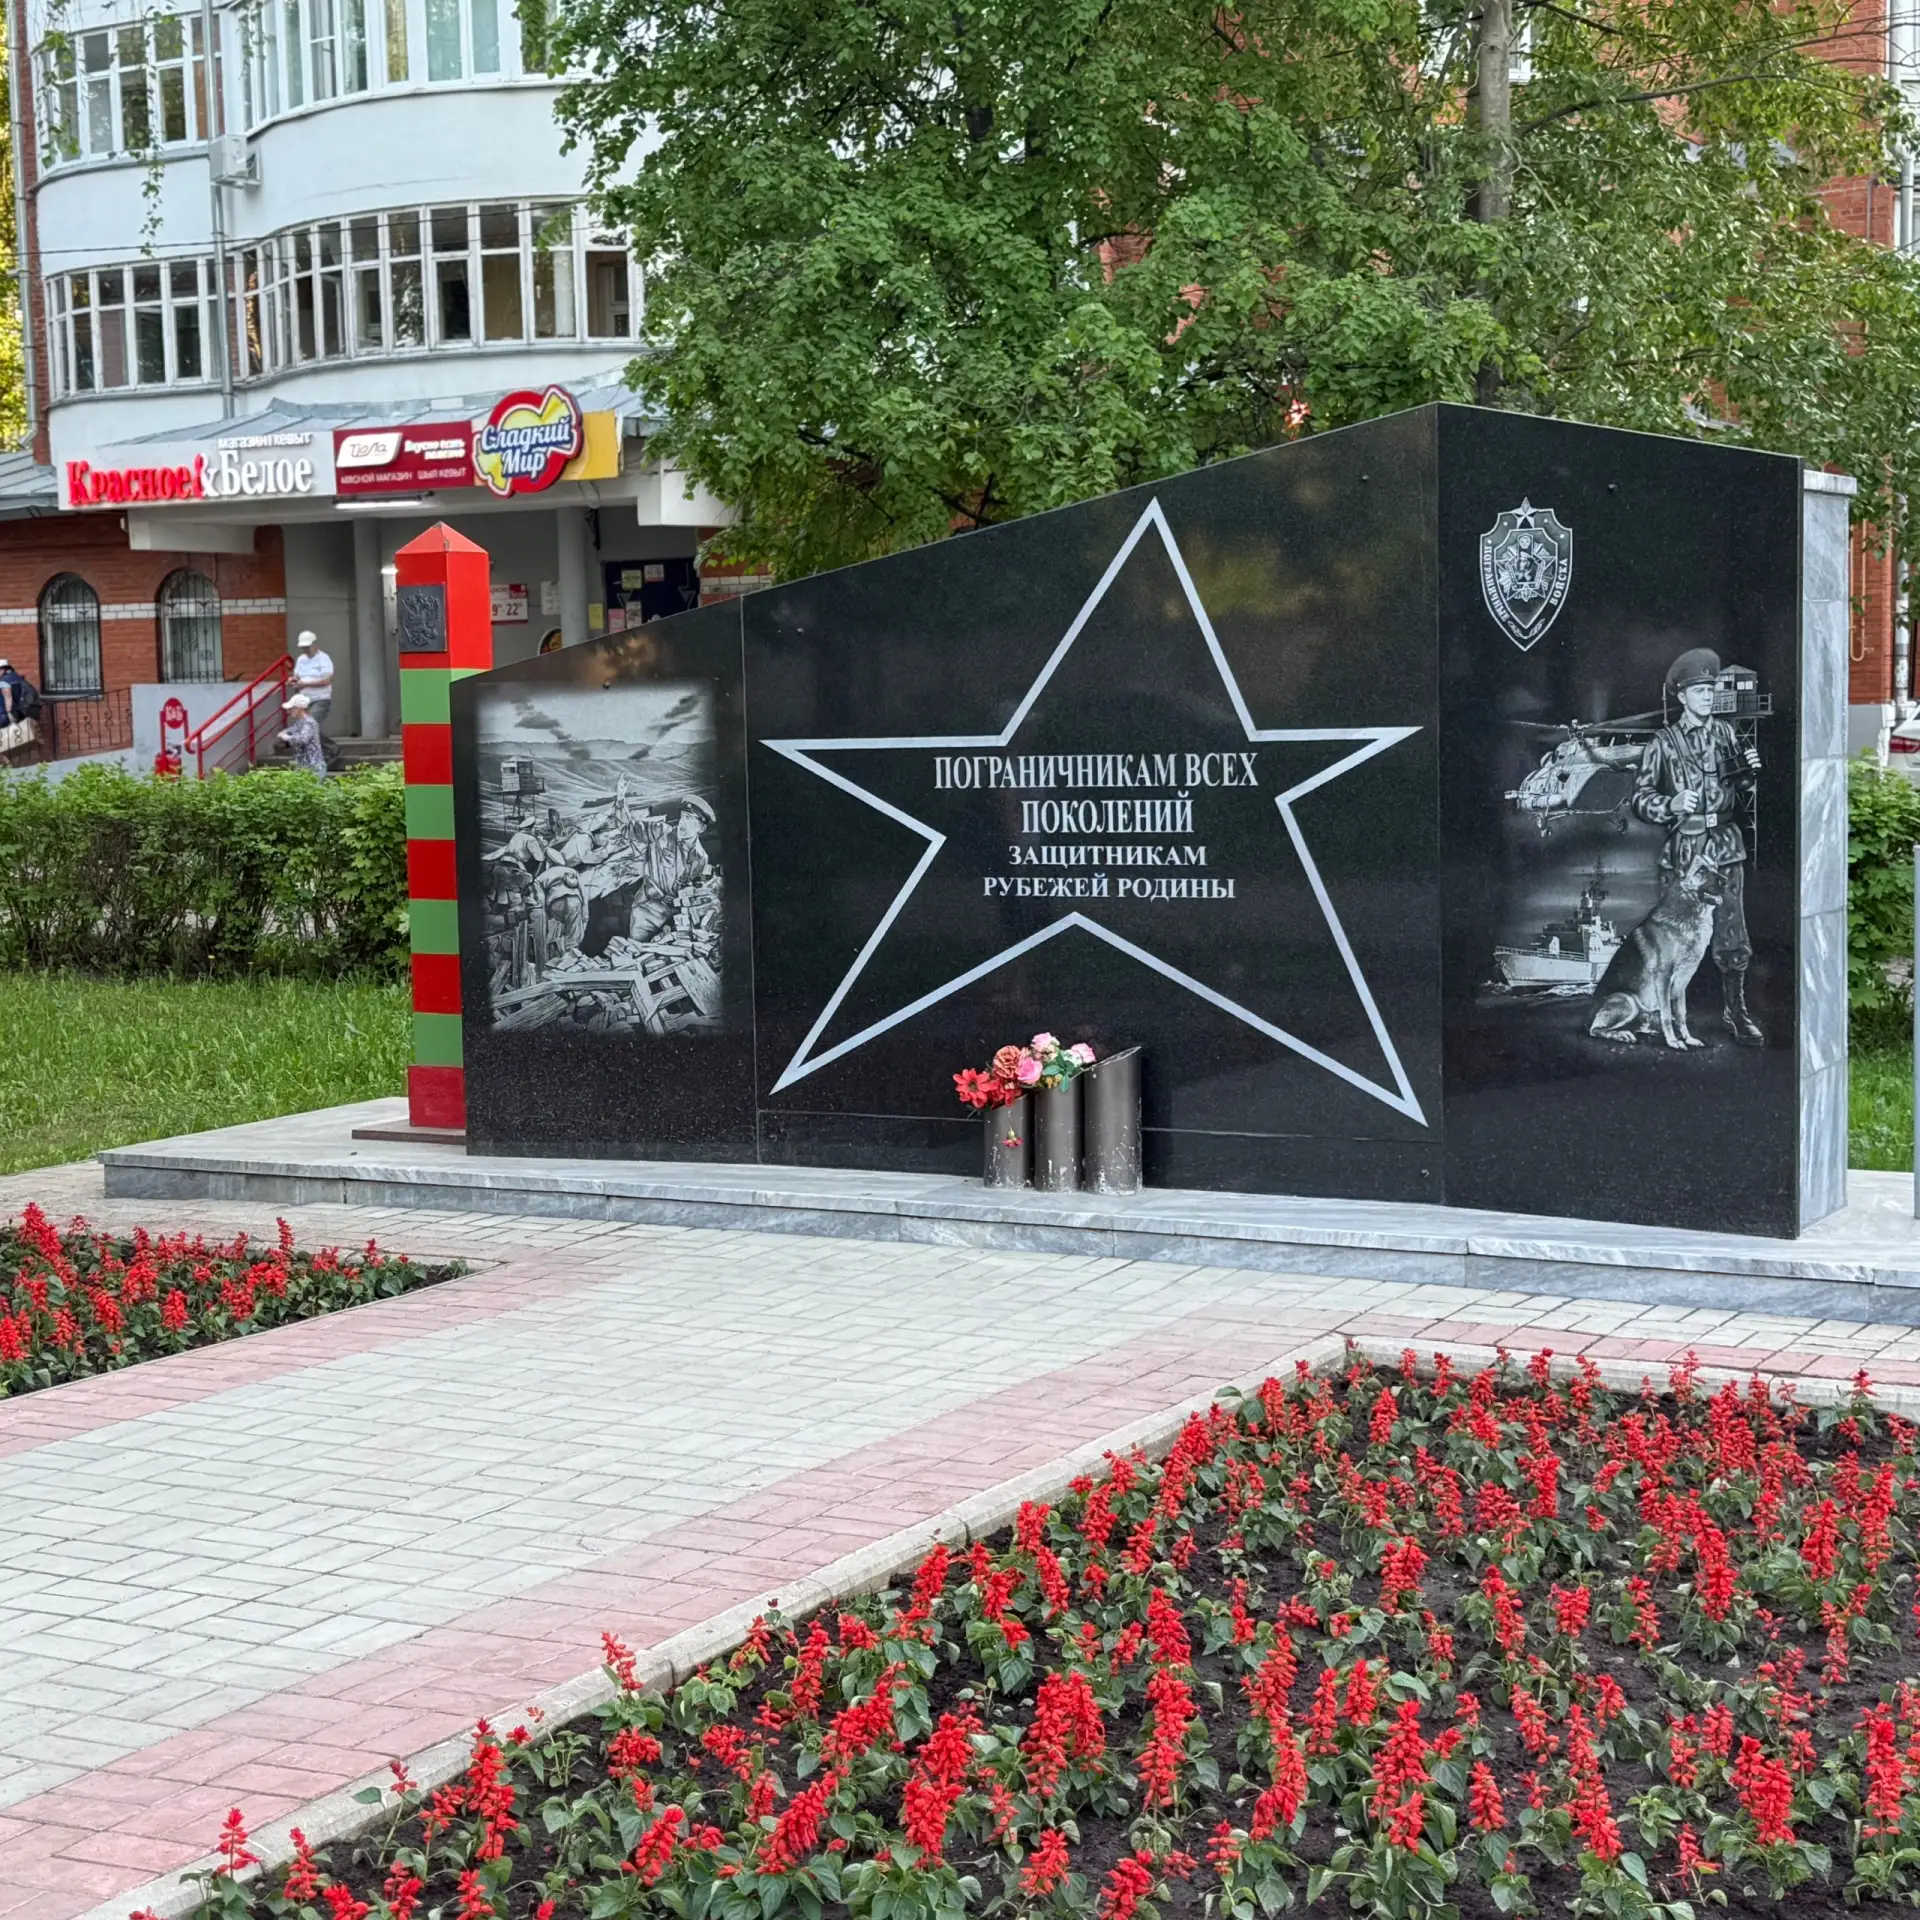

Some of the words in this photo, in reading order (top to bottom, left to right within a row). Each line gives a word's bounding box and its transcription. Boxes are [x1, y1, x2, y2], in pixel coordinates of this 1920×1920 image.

[481, 416, 571, 453] Сладкий
[376, 471, 413, 483] МАГАЗИН
[502, 446, 546, 479] Мир
[1483, 545, 1511, 622] ПОГРАНИЧНЫЕ
[1549, 558, 1568, 606] ВОЙСКА
[934, 753, 1177, 789] ПОГРАНИЧНИКАМ
[1184, 752, 1259, 787] ВСЕХ
[1021, 791, 1195, 833] ПОКОЛЕНИЙ
[1008, 845, 1207, 869] ЗАЩИТНИКАМ
[983, 872, 1110, 897] РУБЕЖЕЙ
[1117, 877, 1236, 901] РОДИНЫ
